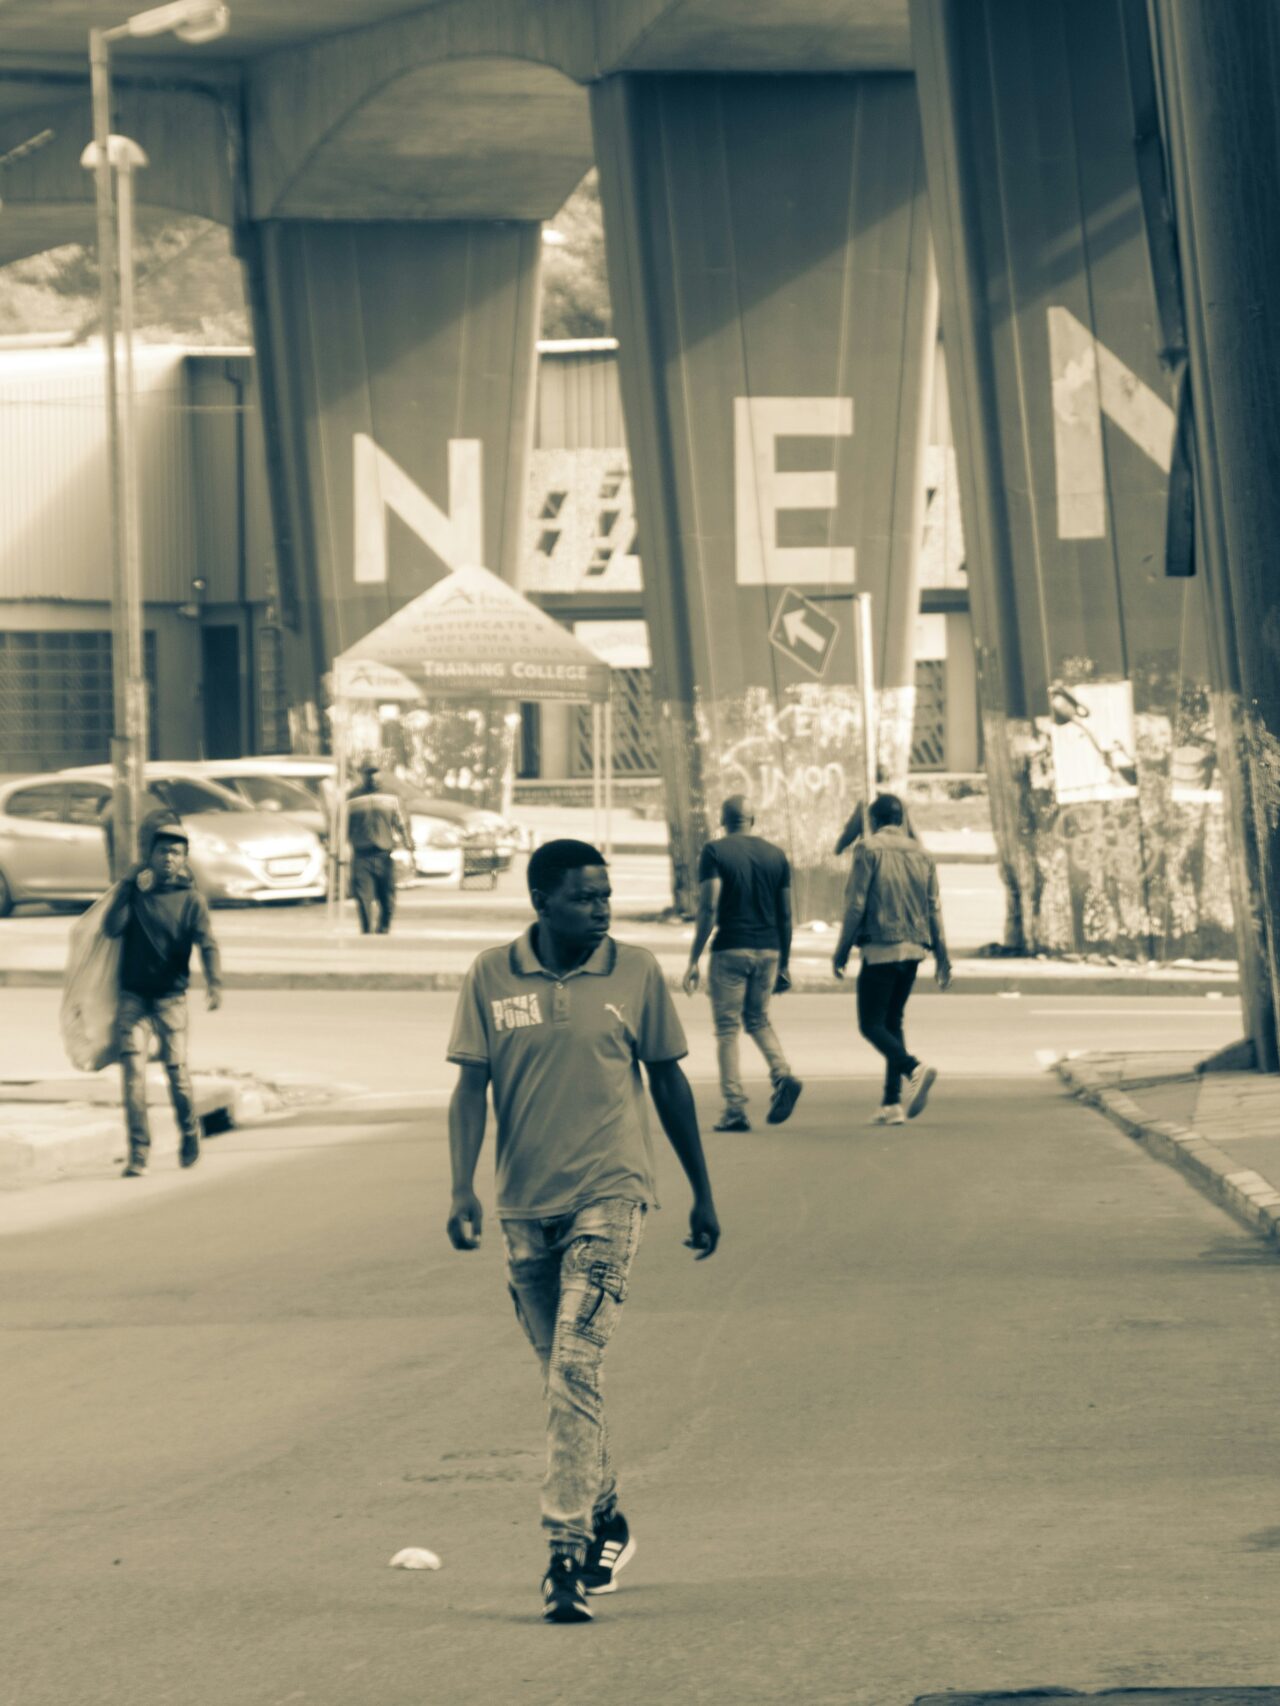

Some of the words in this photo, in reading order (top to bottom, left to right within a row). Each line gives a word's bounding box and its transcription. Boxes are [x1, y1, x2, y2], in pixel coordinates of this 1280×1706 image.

[353, 432, 483, 583] N
[733, 396, 855, 585] E
[422, 660, 505, 677] TRAINING
[511, 660, 588, 680] COLLEGE
